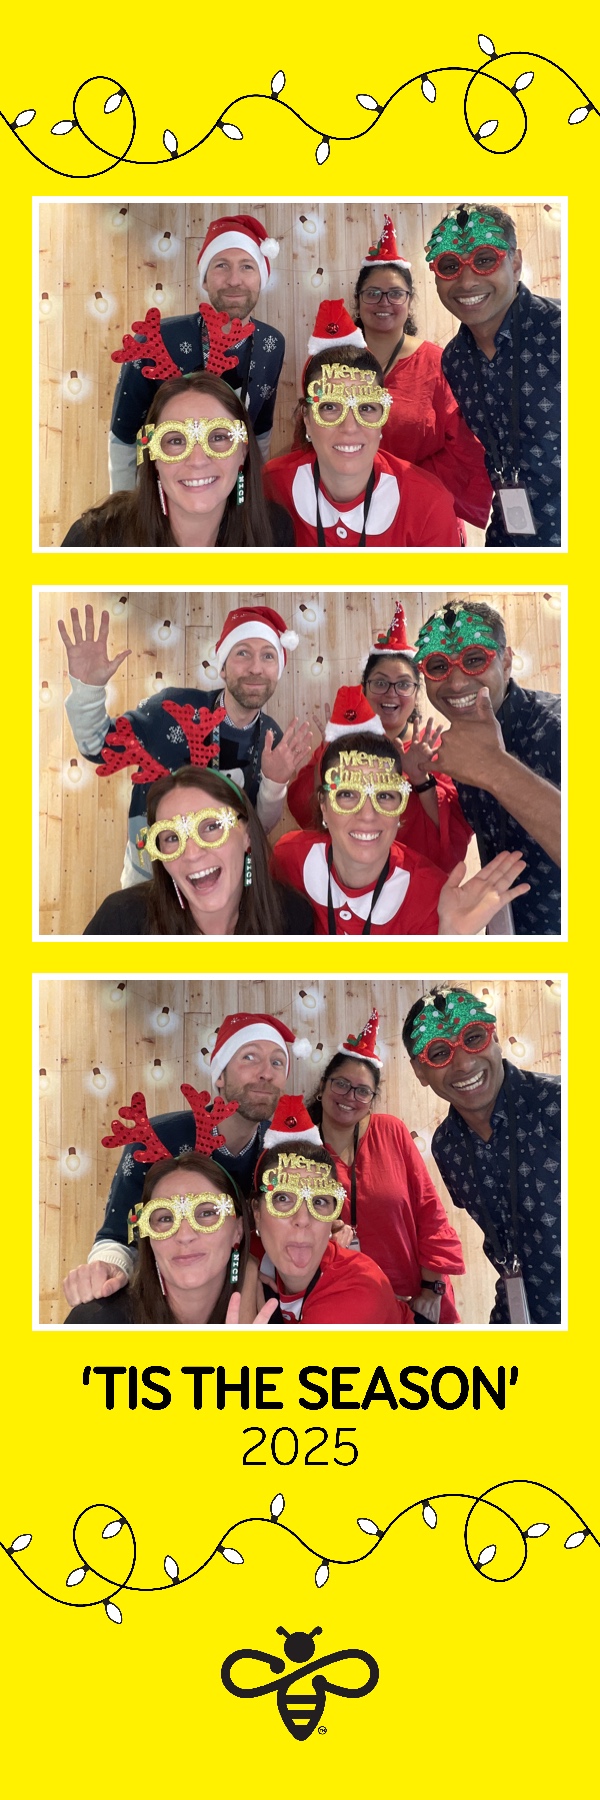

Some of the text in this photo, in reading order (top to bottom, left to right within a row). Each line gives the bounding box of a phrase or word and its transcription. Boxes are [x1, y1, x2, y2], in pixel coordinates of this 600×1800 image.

[321, 363, 376, 385] Merry
[338, 749, 396, 772] Merry
[277, 1152, 332, 1177] Merry
